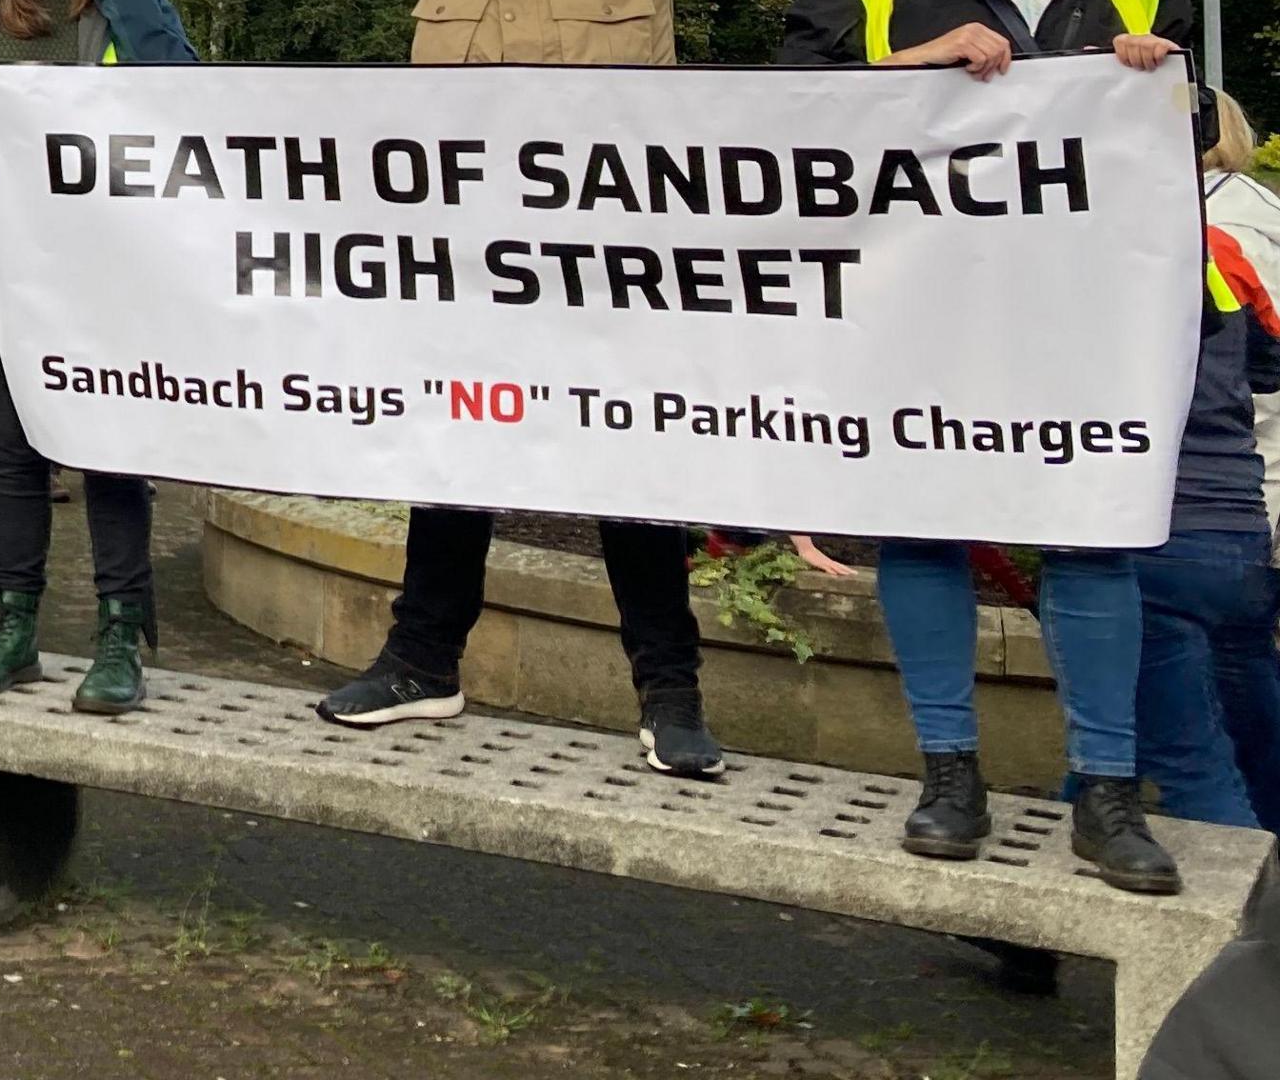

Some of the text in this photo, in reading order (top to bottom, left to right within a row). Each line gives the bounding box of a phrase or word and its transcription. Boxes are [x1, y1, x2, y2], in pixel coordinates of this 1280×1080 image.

[45, 133, 1089, 218] DEATH OF SANDBACH
[236, 231, 861, 319] HIGH STREET
[41, 355, 1151, 464] Sandbach Says "NO" To Parking Charges
